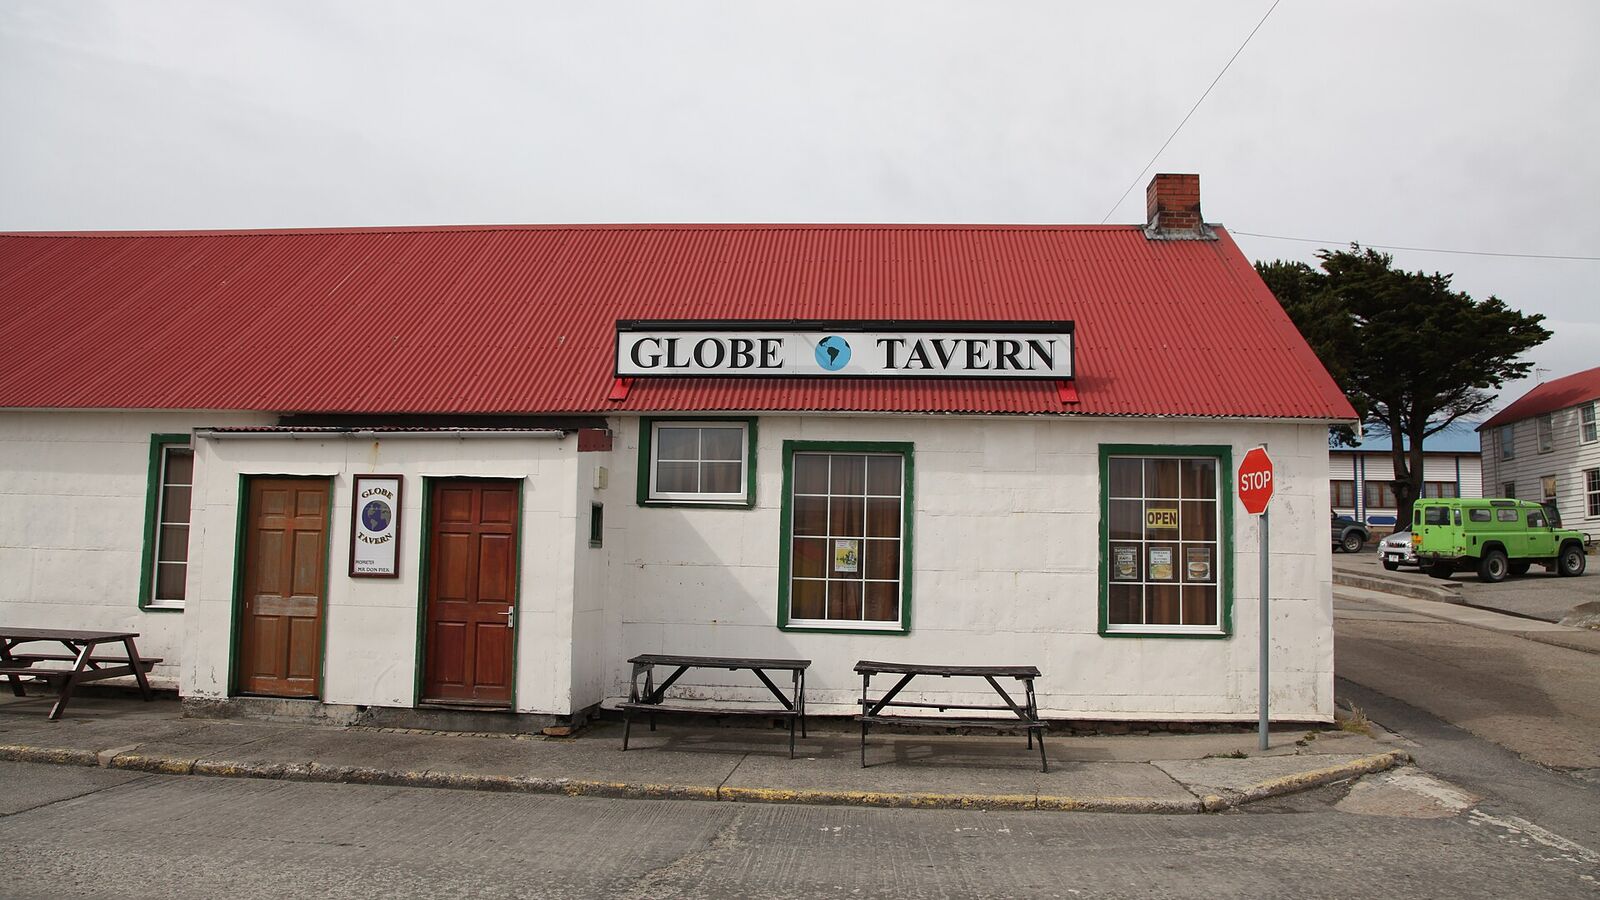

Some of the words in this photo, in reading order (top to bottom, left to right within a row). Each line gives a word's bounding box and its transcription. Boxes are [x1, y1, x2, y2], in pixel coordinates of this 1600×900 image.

[630, 337, 784, 371] GLOBE
[876, 338, 1056, 371] TAVERN
[1241, 470, 1271, 491] STOP
[361, 488, 393, 500] GLOBE
[1147, 512, 1177, 525] OPEN
[358, 531, 393, 545] TAVERN
